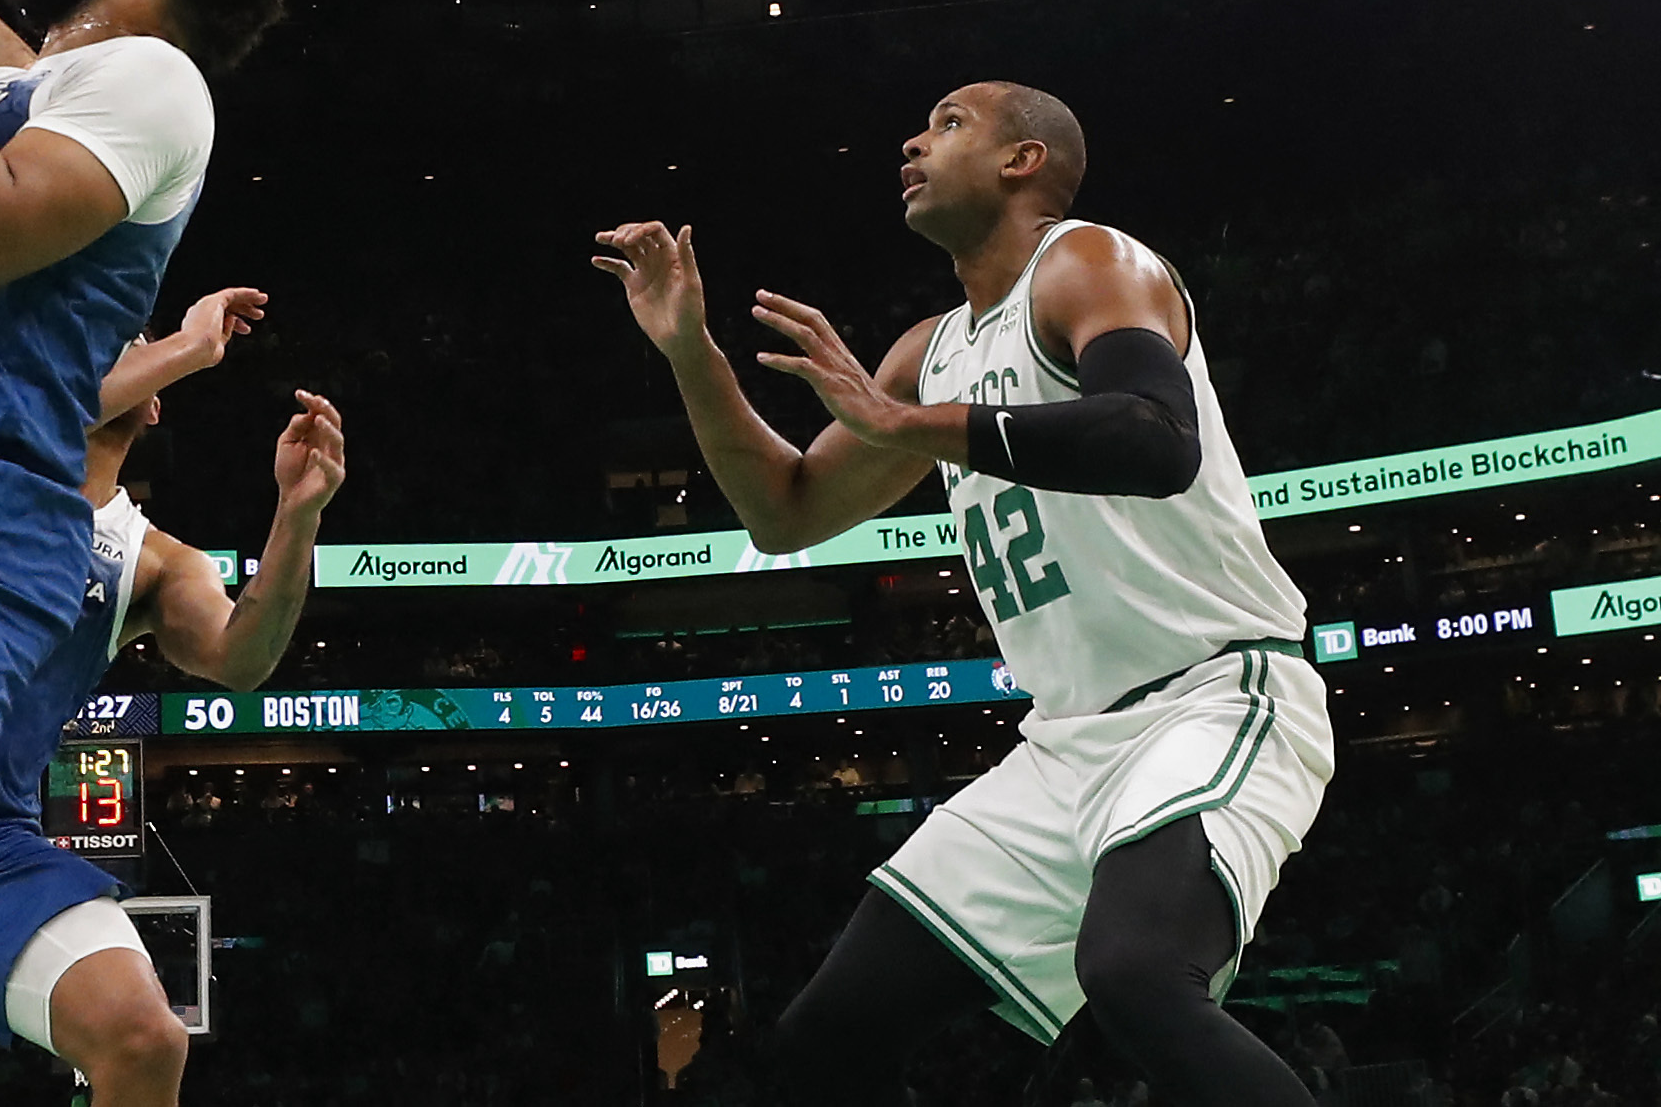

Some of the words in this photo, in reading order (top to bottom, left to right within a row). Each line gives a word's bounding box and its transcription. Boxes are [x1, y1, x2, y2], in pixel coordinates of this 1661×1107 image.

[1300, 460, 1463, 502] Sustainable
[1472, 433, 1628, 474] Blockchain
[91, 541, 124, 561] URA
[878, 525, 926, 550] The
[964, 483, 1072, 624] 42
[350, 550, 467, 581] Algorand
[594, 544, 712, 574] Algorand
[1590, 590, 1661, 621] Algo
[1320, 628, 1352, 656] TD
[1363, 623, 1416, 648] Bank
[1437, 612, 1487, 640] 8:00
[1494, 607, 1533, 631] PM
[493, 692, 512, 702] FLS
[533, 691, 555, 702] TOL
[577, 690, 604, 701] FG%
[646, 686, 662, 697] FG
[721, 680, 743, 692] 3PT
[785, 676, 803, 688] TO
[831, 673, 851, 684] STL
[878, 669, 900, 681] AST
[926, 666, 949, 678] REB
[185, 697, 234, 730] 50
[263, 695, 359, 727] BOSTON
[498, 707, 511, 724] 4
[540, 706, 552, 723] 5
[580, 706, 603, 722] 44
[631, 700, 681, 720] 16/36
[718, 694, 757, 714] 8/21
[789, 691, 802, 708] 4
[840, 688, 848, 705] 1
[882, 684, 903, 702] 10
[928, 681, 951, 700] 20
[80, 749, 129, 776] 1:27
[79, 777, 125, 828] 13
[71, 834, 138, 849] TISSOT
